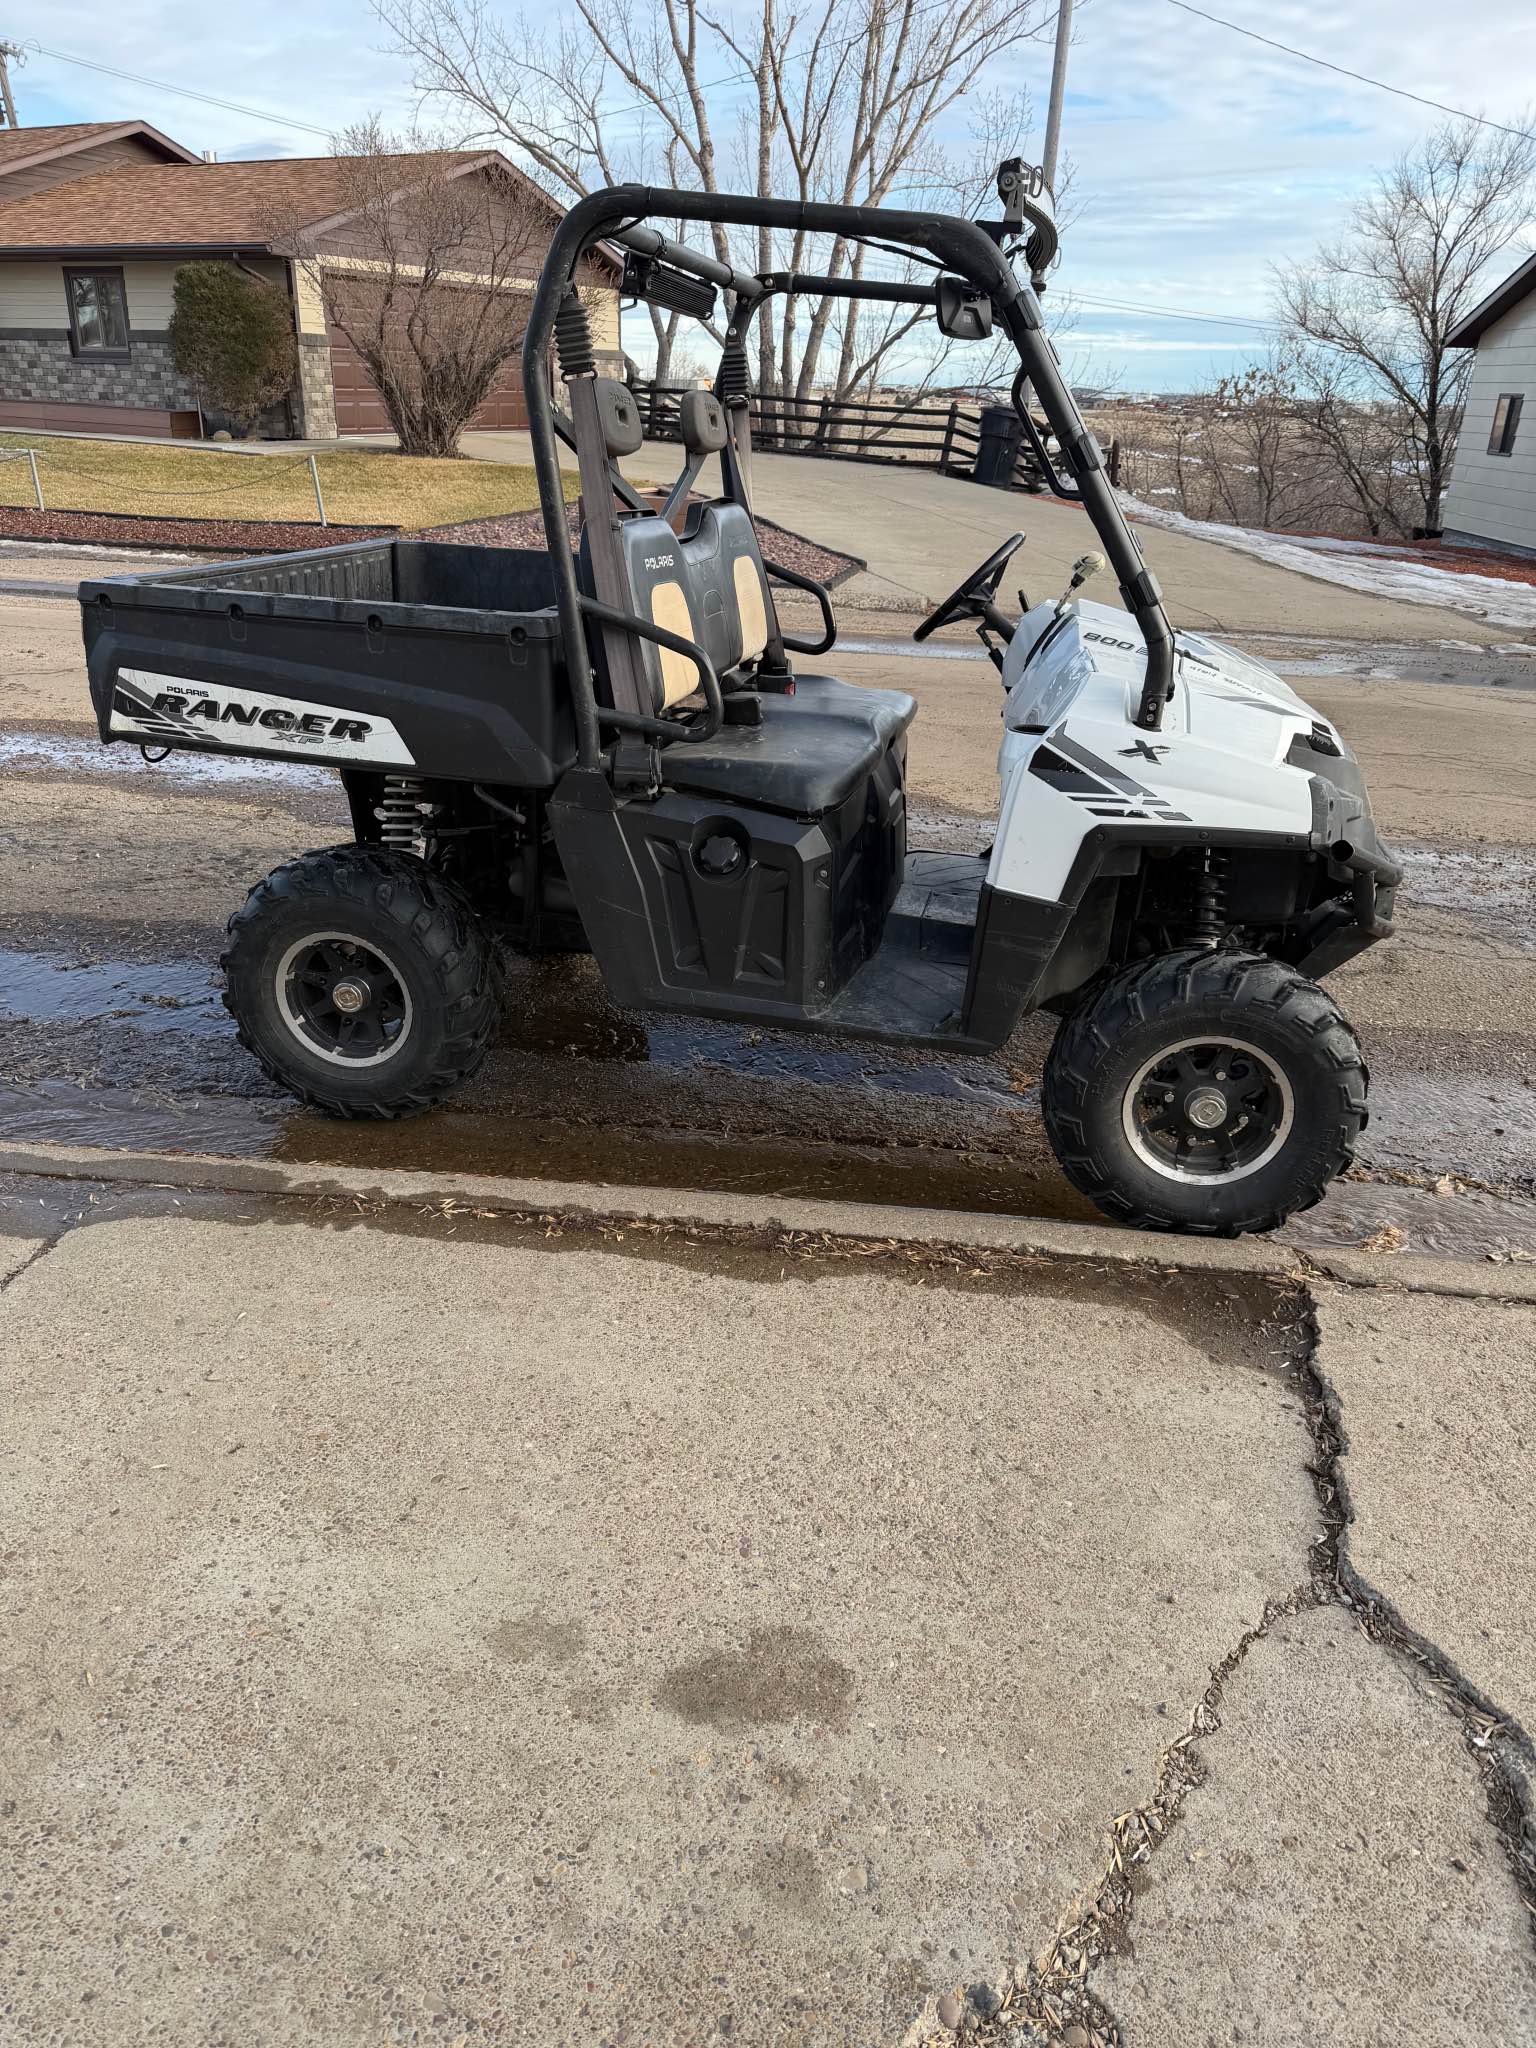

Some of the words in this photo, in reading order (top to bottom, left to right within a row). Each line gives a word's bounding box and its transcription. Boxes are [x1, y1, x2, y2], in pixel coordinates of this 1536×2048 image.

[643, 555, 674, 568] POLARIS
[1084, 632, 1134, 651] 800
[167, 686, 209, 698] POLARIS
[150, 693, 372, 742] RANGER
[270, 731, 325, 745] XP
